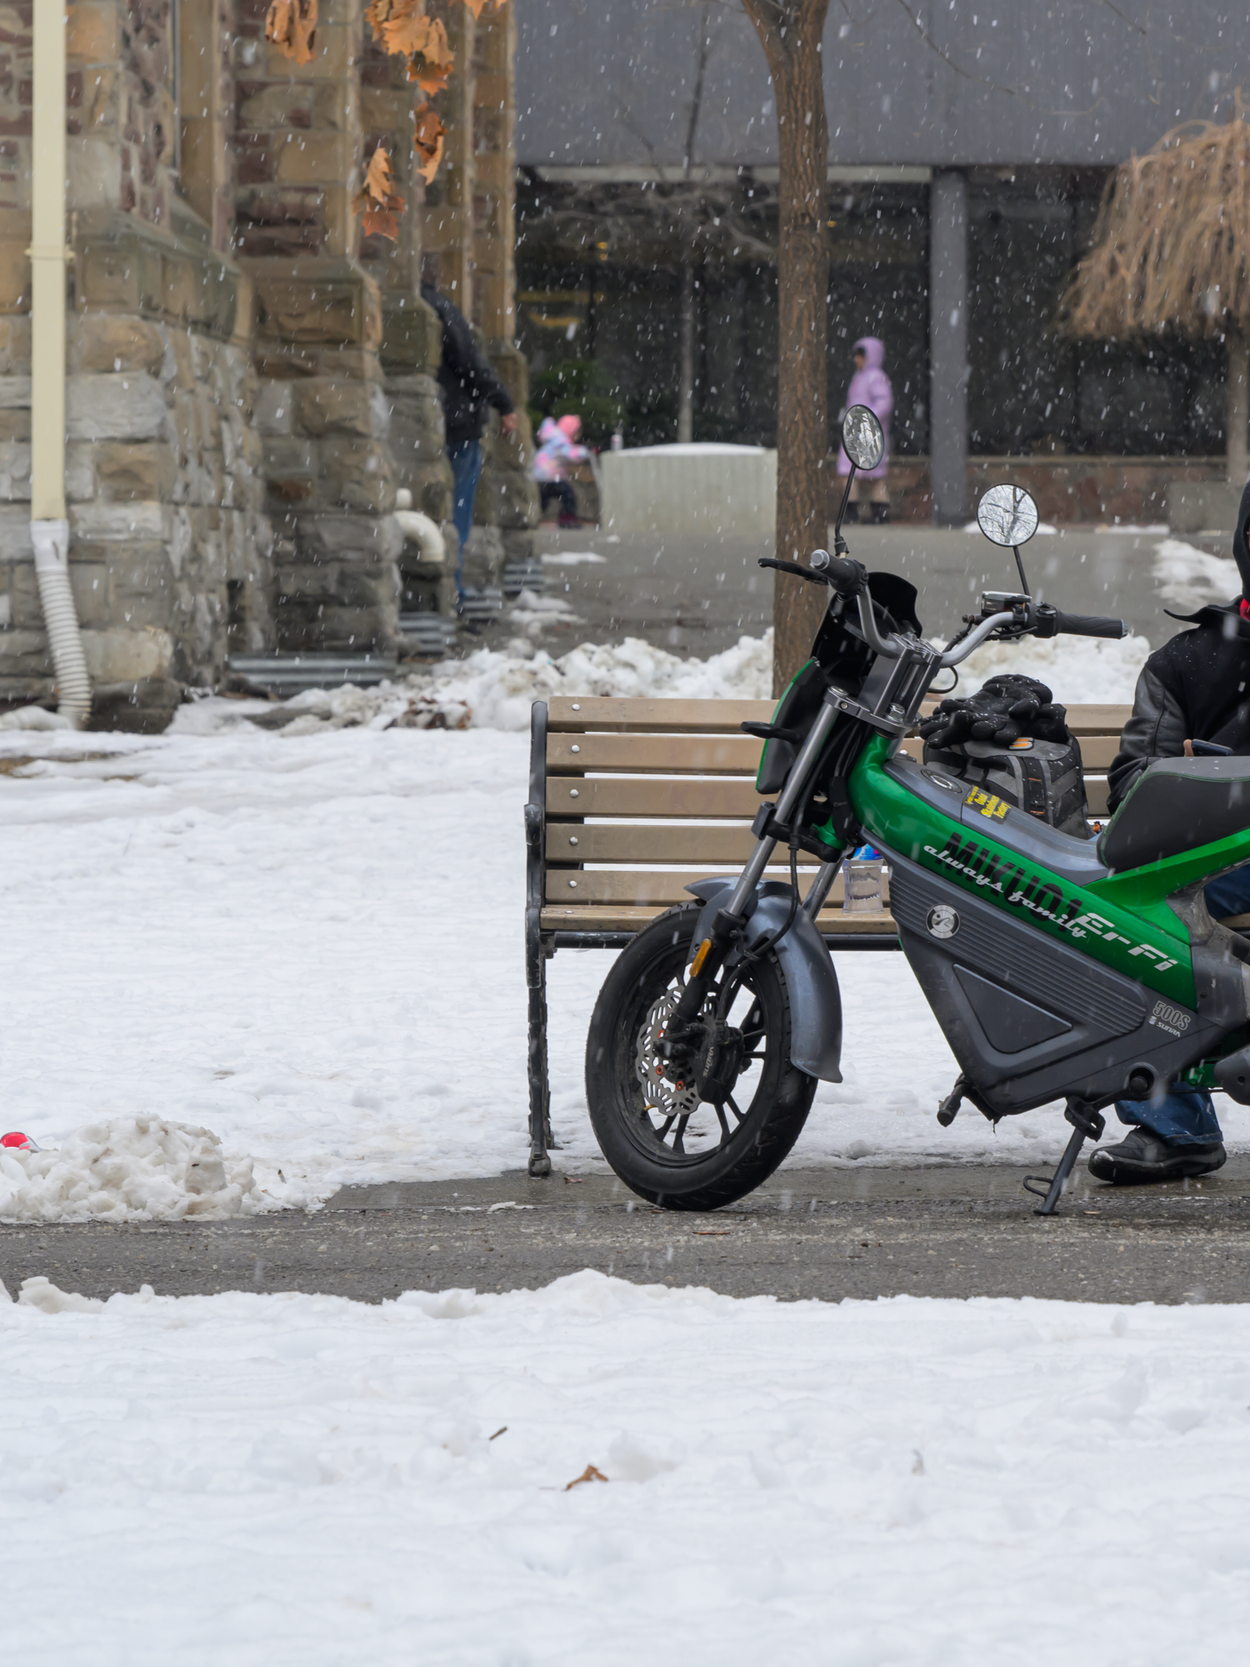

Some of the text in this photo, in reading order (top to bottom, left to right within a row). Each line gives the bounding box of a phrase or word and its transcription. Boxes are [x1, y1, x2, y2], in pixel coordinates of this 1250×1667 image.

[923, 845, 1087, 938] always family
[1152, 1000, 1192, 1031] 500S
